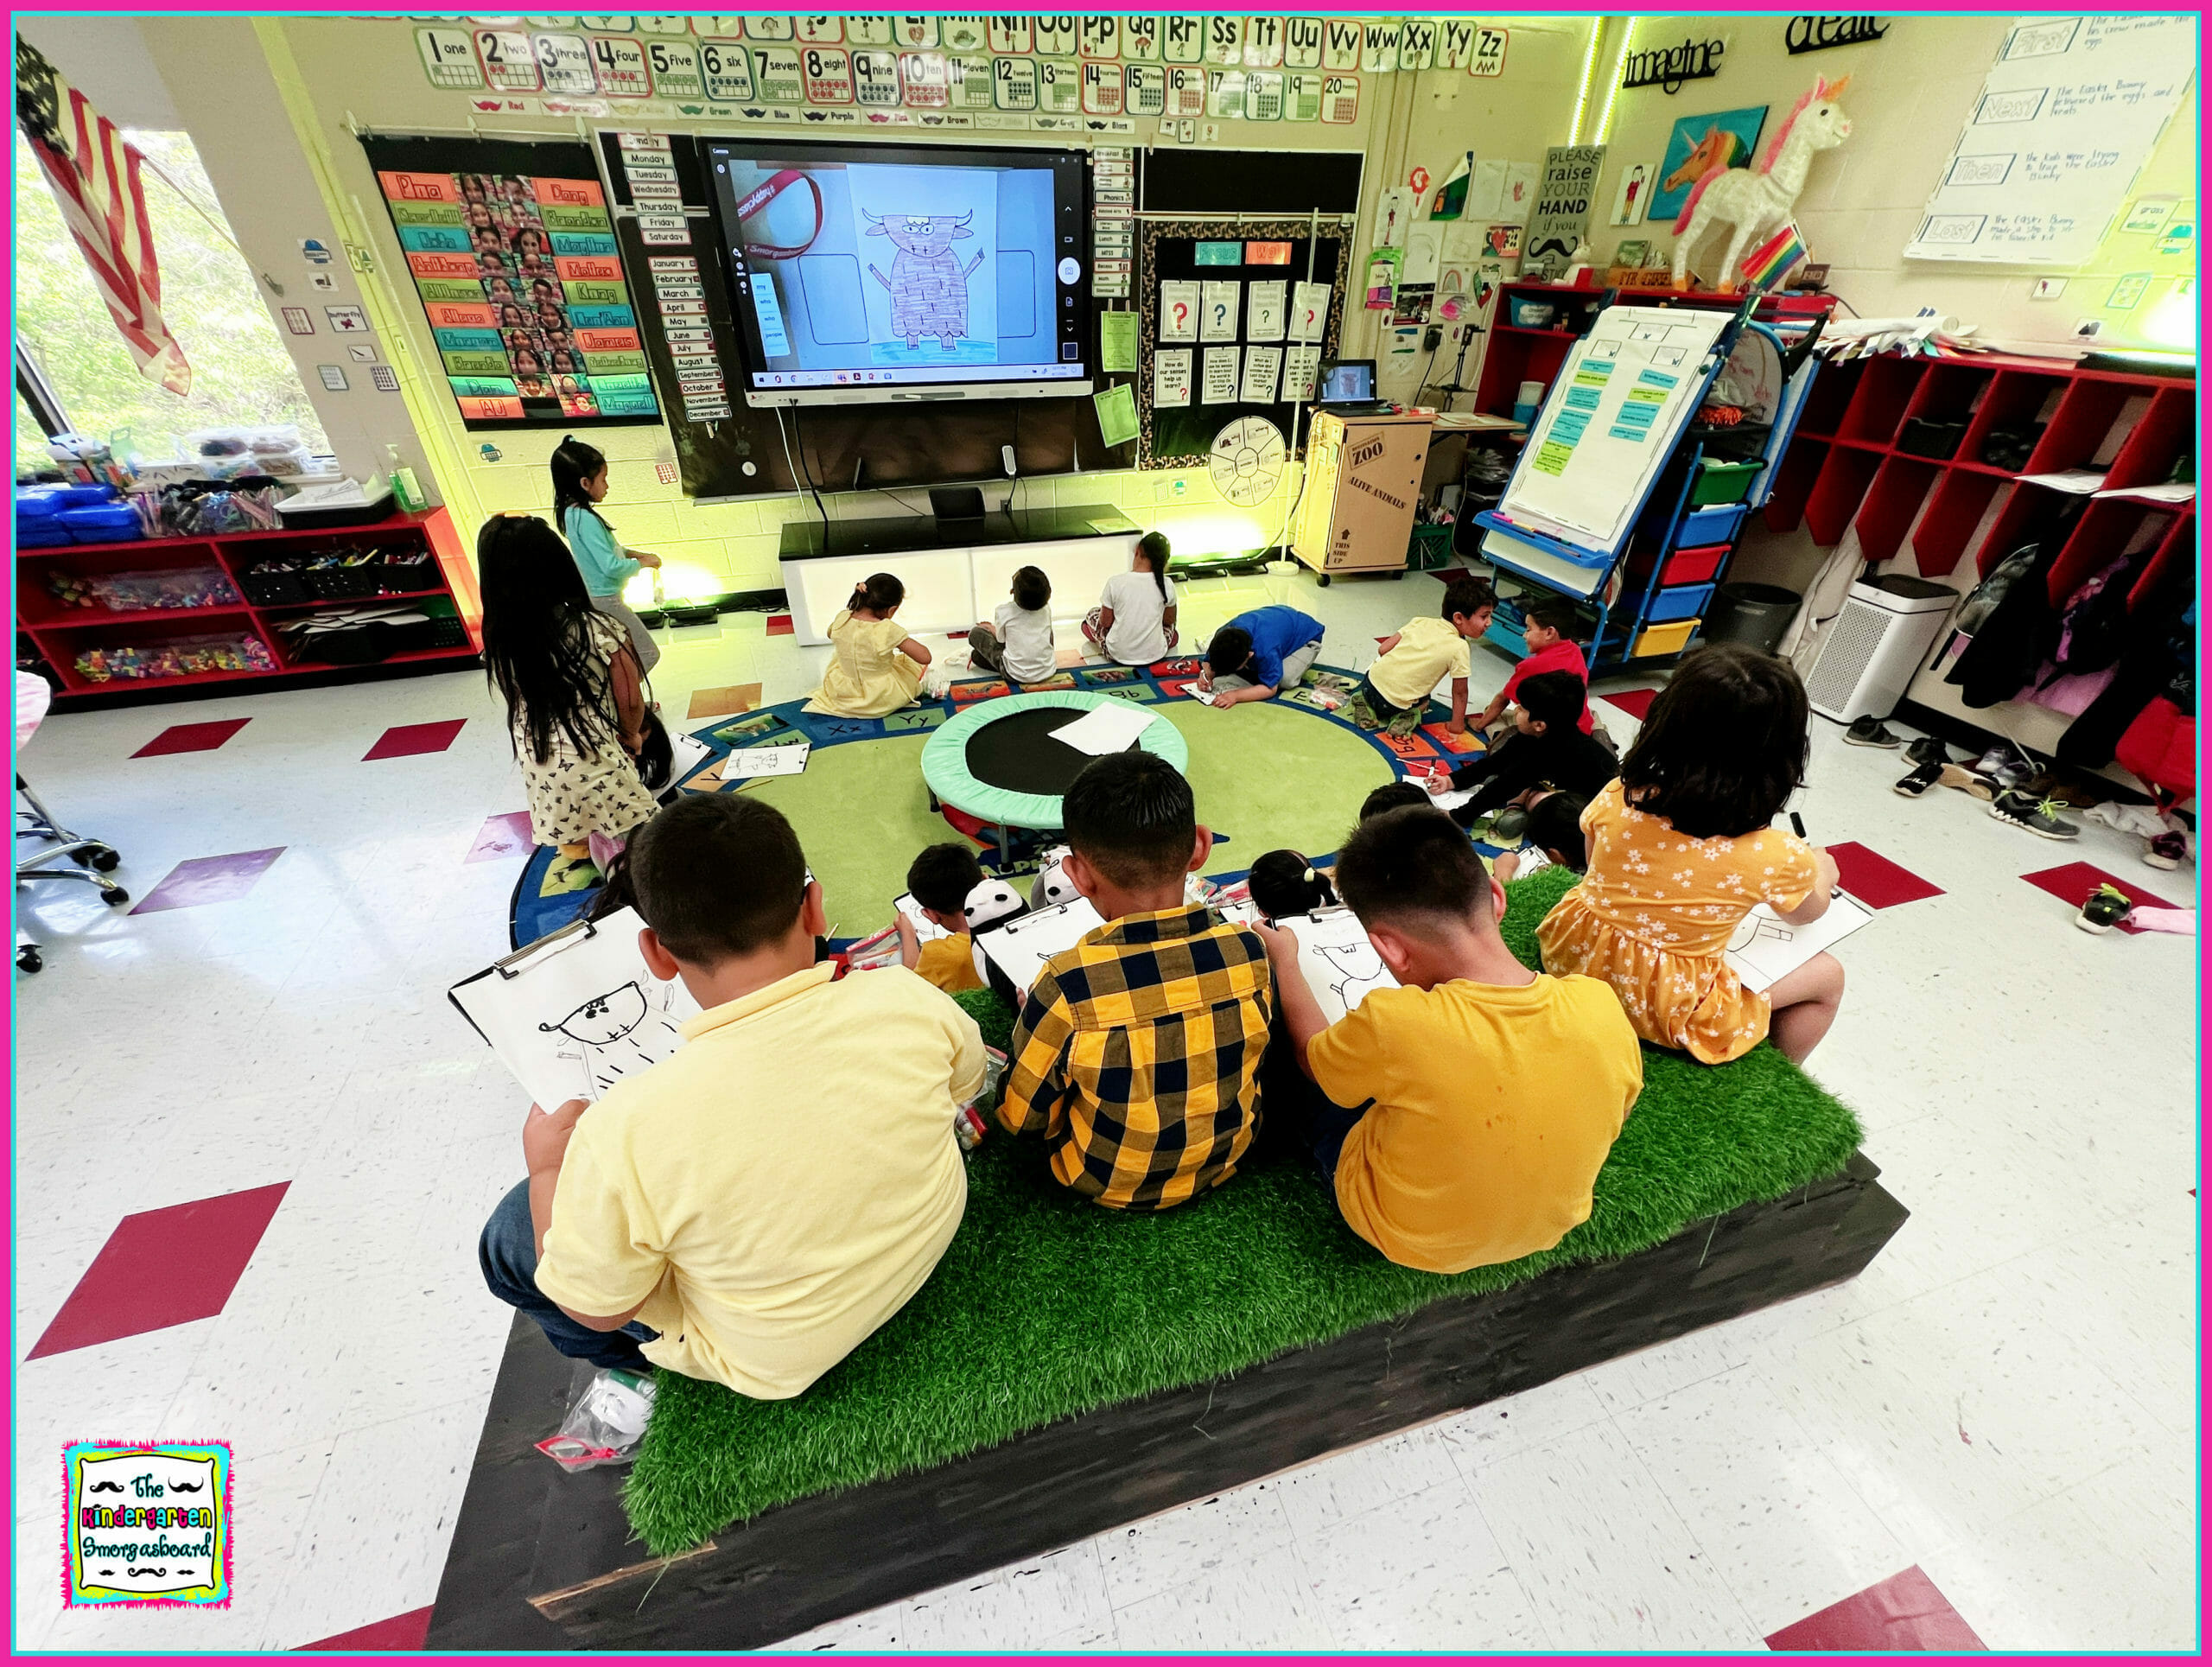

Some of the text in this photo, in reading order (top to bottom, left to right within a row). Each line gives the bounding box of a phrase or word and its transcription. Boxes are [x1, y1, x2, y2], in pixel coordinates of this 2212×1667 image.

[1084, 16, 1115, 43] Pp
[1128, 16, 1155, 40] Qq
[1169, 16, 1198, 41] Rr
[1212, 18, 1236, 43] Ss
[1255, 18, 1276, 46] Tt
[1291, 20, 1319, 48] Uu
[1329, 22, 1358, 50] Vv
[1366, 27, 1398, 48] Ww
[1404, 24, 1433, 50] Xx
[429, 33, 467, 62] 1 one
[481, 33, 527, 62] 2 two
[1446, 22, 1471, 55] Yy
[1478, 31, 1502, 57] Zz
[539, 39, 587, 67] 3 three
[595, 41, 640, 69] 4 four
[650, 45, 692, 73] 5 five
[704, 47, 741, 74] 6 six
[754, 52, 799, 80] 7 seven
[808, 51, 846, 78] 8 eight
[856, 55, 893, 82] 9 nine
[906, 55, 942, 82] 10 ten
[951, 59, 988, 84] 11 eleven
[997, 60, 1012, 80] 12
[1041, 64, 1056, 84] 13
[1623, 35, 1725, 94] imagine
[1085, 66, 1101, 86] 14
[1128, 68, 1164, 87] 15 fifteen
[1170, 70, 1184, 89] 16
[1211, 72, 1224, 92] 17
[1249, 74, 1262, 93] 18
[1289, 76, 1302, 94] 19
[1325, 79, 1342, 94] 20
[508, 101, 524, 111] Red
[709, 107, 732, 116] Green
[1980, 96, 2039, 119] Next
[830, 112, 854, 121] Purple
[947, 116, 969, 124] Brown
[631, 155, 664, 165] Monday
[1549, 149, 1601, 165] PLEASE
[634, 170, 667, 180] Tuesday
[1548, 164, 1592, 181] raise
[1954, 160, 2004, 181] Then
[633, 186, 677, 194] Wednesday
[1544, 182, 1590, 197] YOUR
[640, 202, 677, 212] Thursday
[1538, 199, 1587, 215] HAND
[650, 219, 675, 227] Friday
[1542, 218, 1577, 234] if you
[1929, 221, 1977, 240] Last
[649, 232, 683, 242] Saturday
[1200, 245, 1237, 259] Focus
[653, 259, 684, 269] January
[655, 275, 692, 283] February
[666, 304, 685, 313] April
[670, 318, 687, 327] May
[582, 333, 635, 348] James
[677, 344, 691, 353] July
[678, 358, 703, 366] August
[680, 370, 714, 379] September
[683, 383, 713, 392] October
[480, 399, 507, 417] AJ
[1352, 442, 1382, 466] ZOO
[1348, 477, 1407, 509] ALIVE ANIMALS
[828, 724, 861, 735] Xx
[899, 715, 930, 727] Yy
